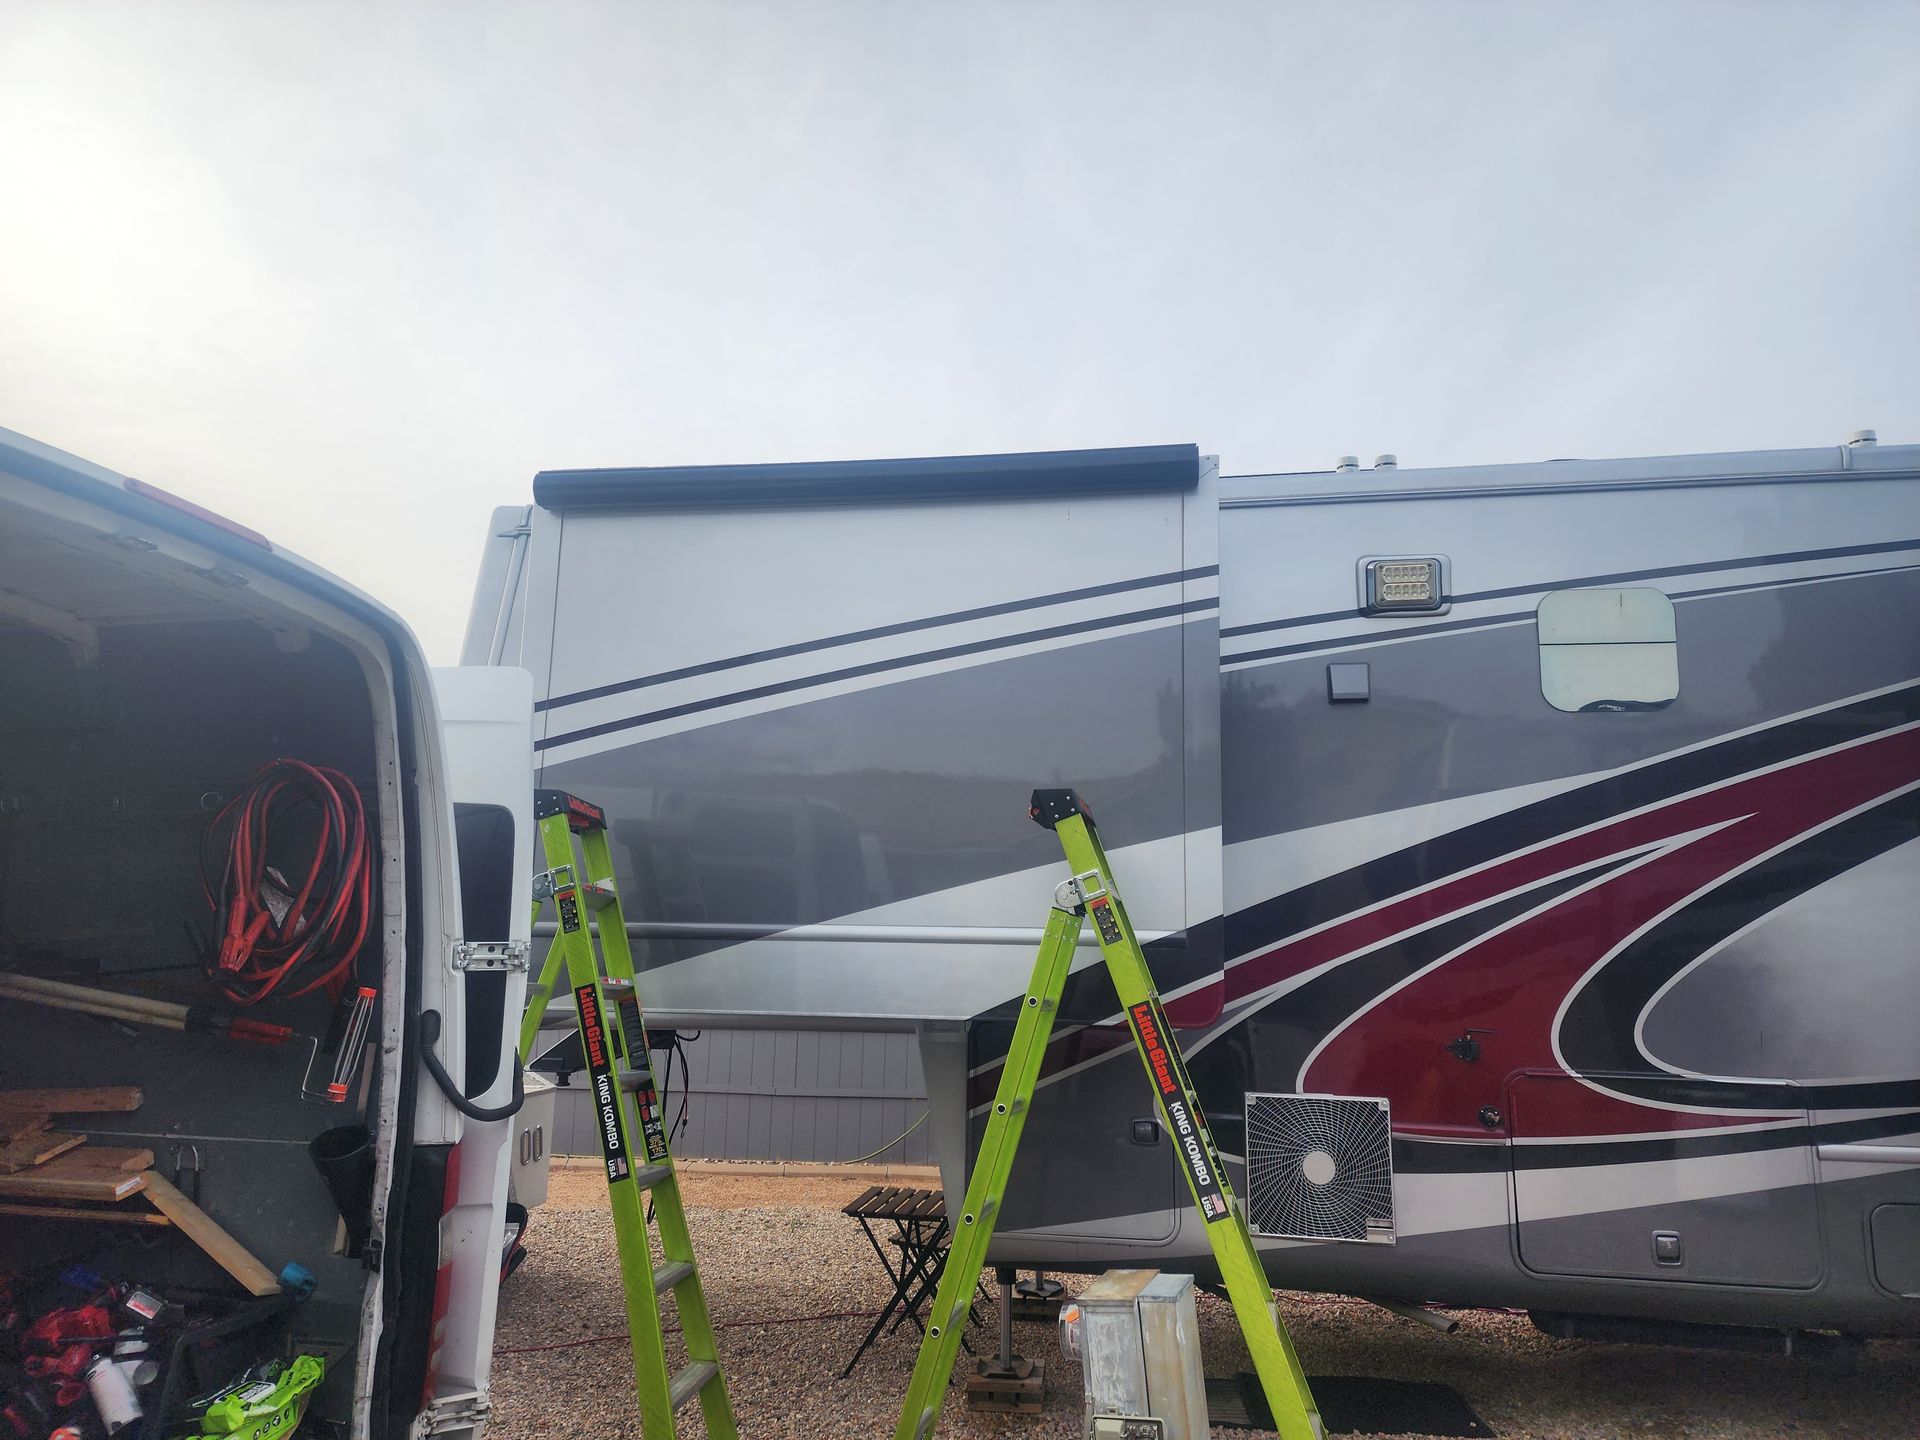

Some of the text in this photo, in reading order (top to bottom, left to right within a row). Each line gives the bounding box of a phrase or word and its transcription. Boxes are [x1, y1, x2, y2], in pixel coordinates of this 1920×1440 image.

[597, 1074, 619, 1150] KING KOMBO
[1170, 1101, 1191, 1135] KING
[1183, 1135, 1211, 1186] KOMBO
[608, 1160, 616, 1179] USA
[1201, 1196, 1214, 1219] USA
